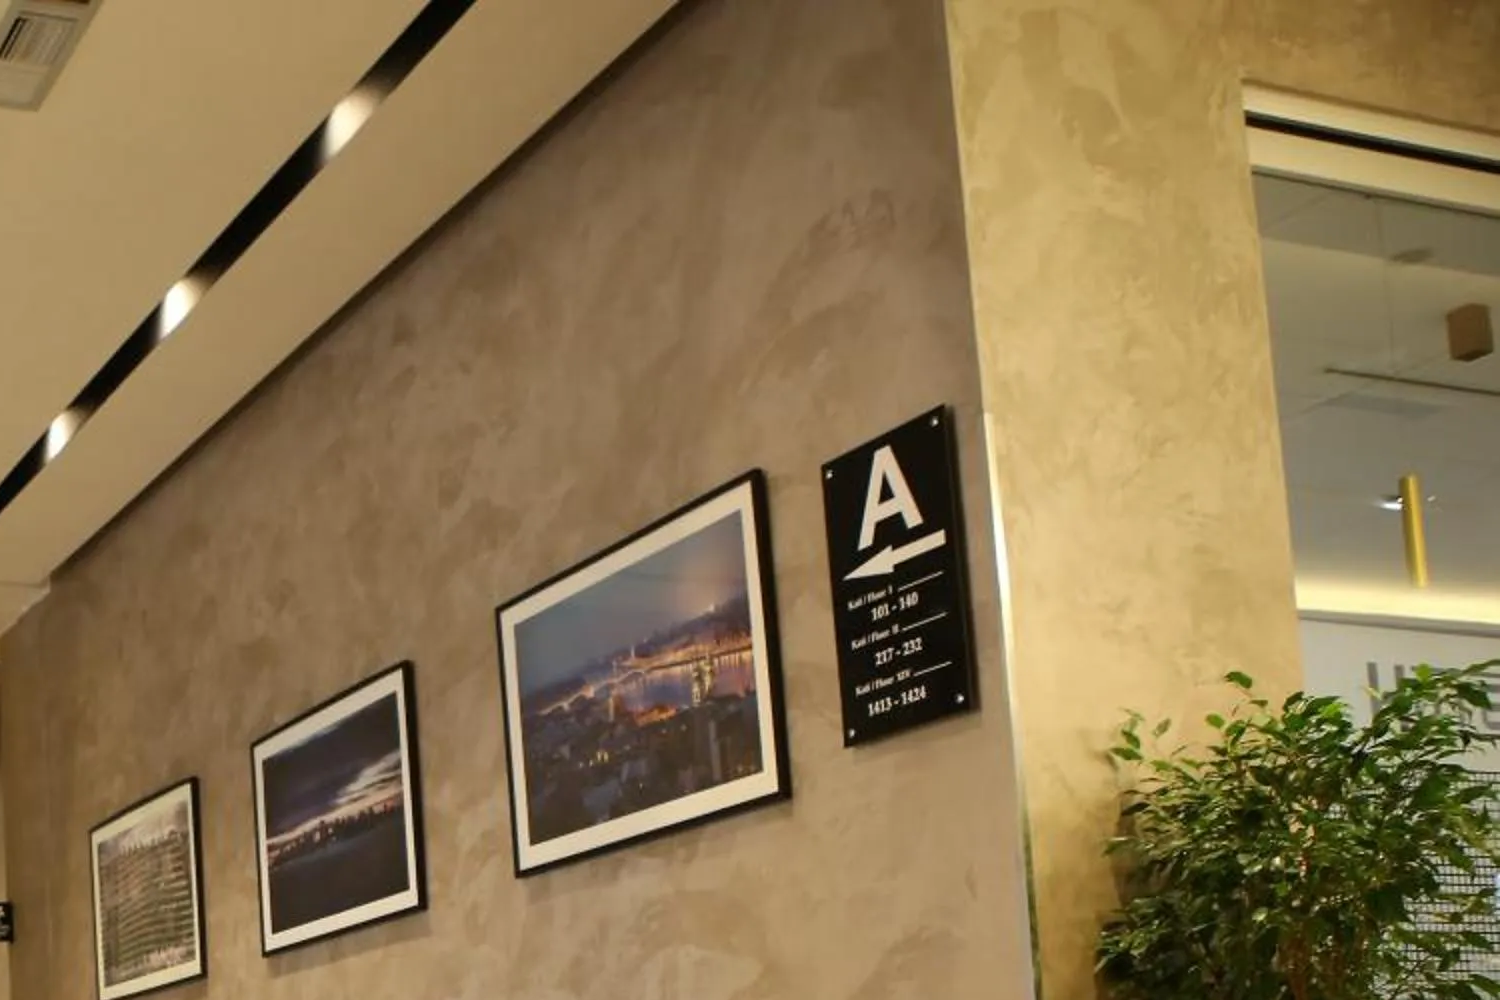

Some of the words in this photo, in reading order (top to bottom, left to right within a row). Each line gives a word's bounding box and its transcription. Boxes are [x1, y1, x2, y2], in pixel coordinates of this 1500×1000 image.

[857, 444, 924, 551] A
[871, 603, 890, 621] 101
[900, 591, 919, 611] 140
